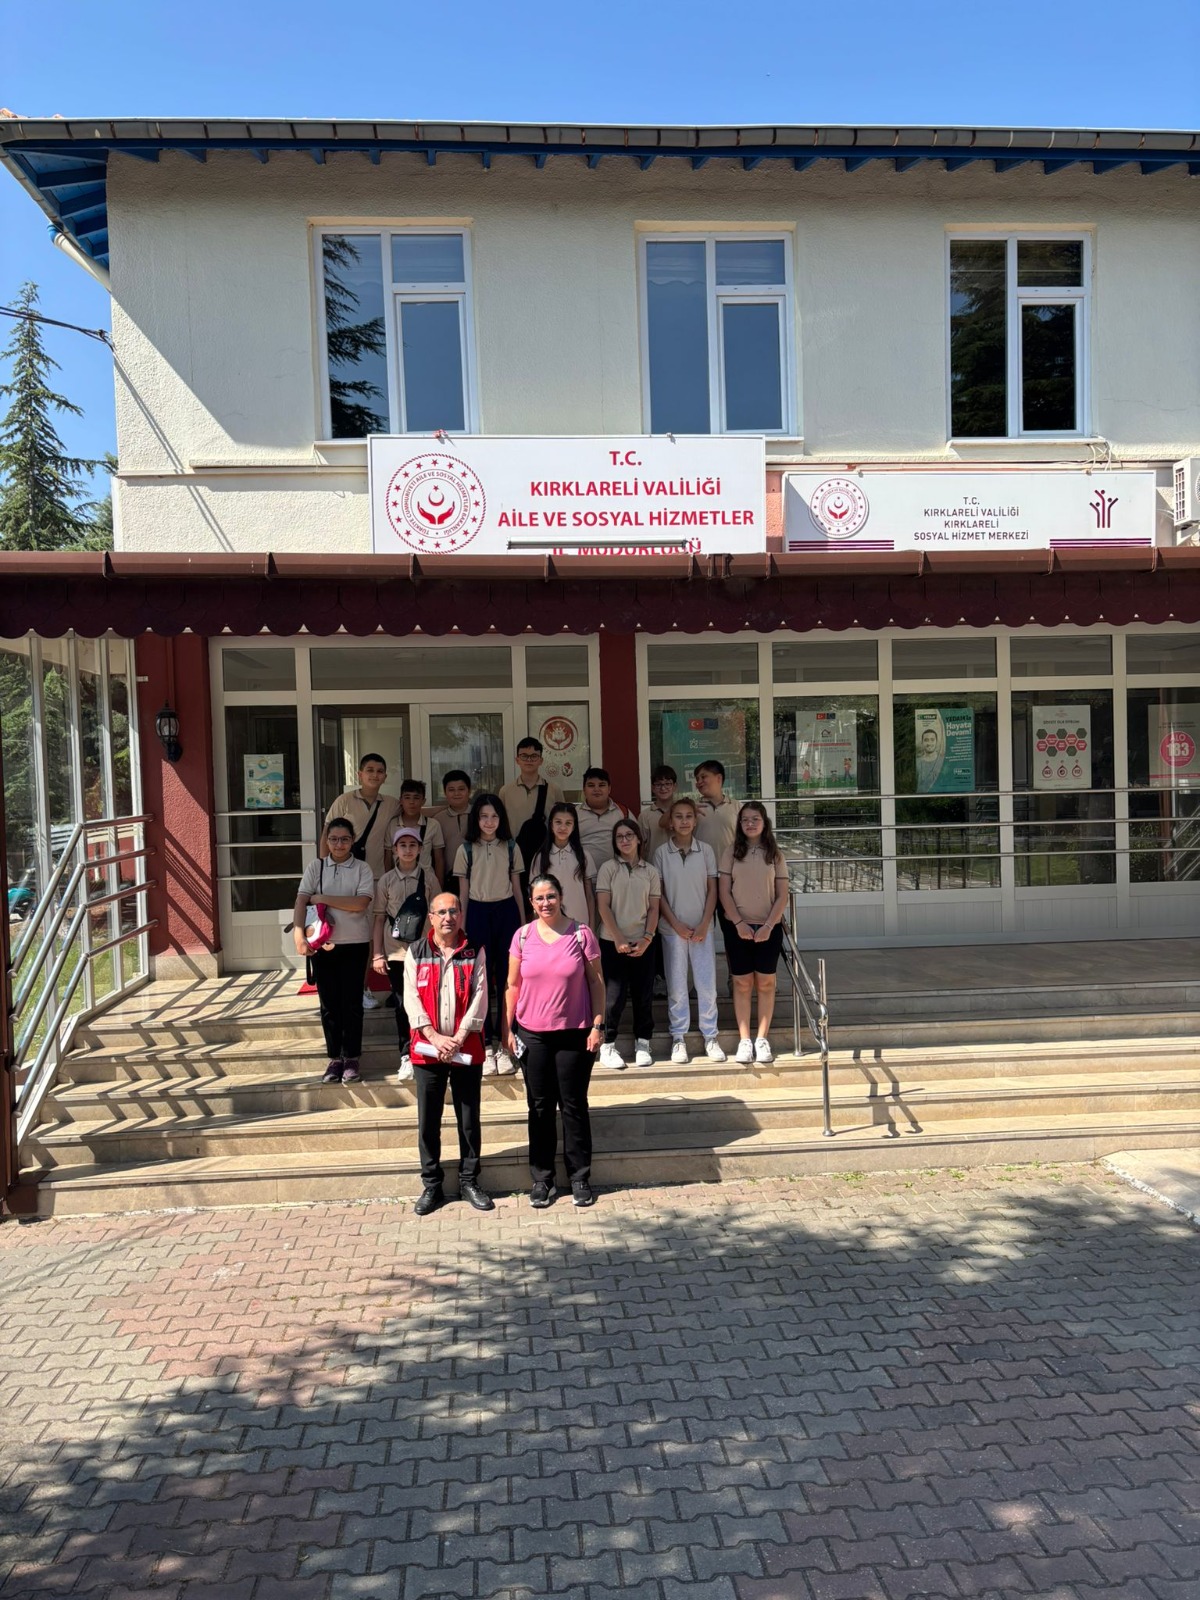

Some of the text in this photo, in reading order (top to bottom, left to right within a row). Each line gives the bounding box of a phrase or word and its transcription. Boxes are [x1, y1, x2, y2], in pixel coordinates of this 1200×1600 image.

[609, 450, 642, 466] T.C.
[530, 477, 721, 497] KIRKLARELİ VALİLİĞİ
[963, 496, 980, 505] T.C.
[924, 506, 1019, 517] KIRKLARELİ VALİLİĞİ
[497, 508, 754, 528] AİLE VE SOSYAL HİZMETLER
[944, 518, 999, 529] KIRKLARELİ
[914, 530, 1029, 541] SOSYAL HİZMET MERKEZİ
[946, 722, 972, 730] Hayata
[1166, 742, 1190, 757] 183
